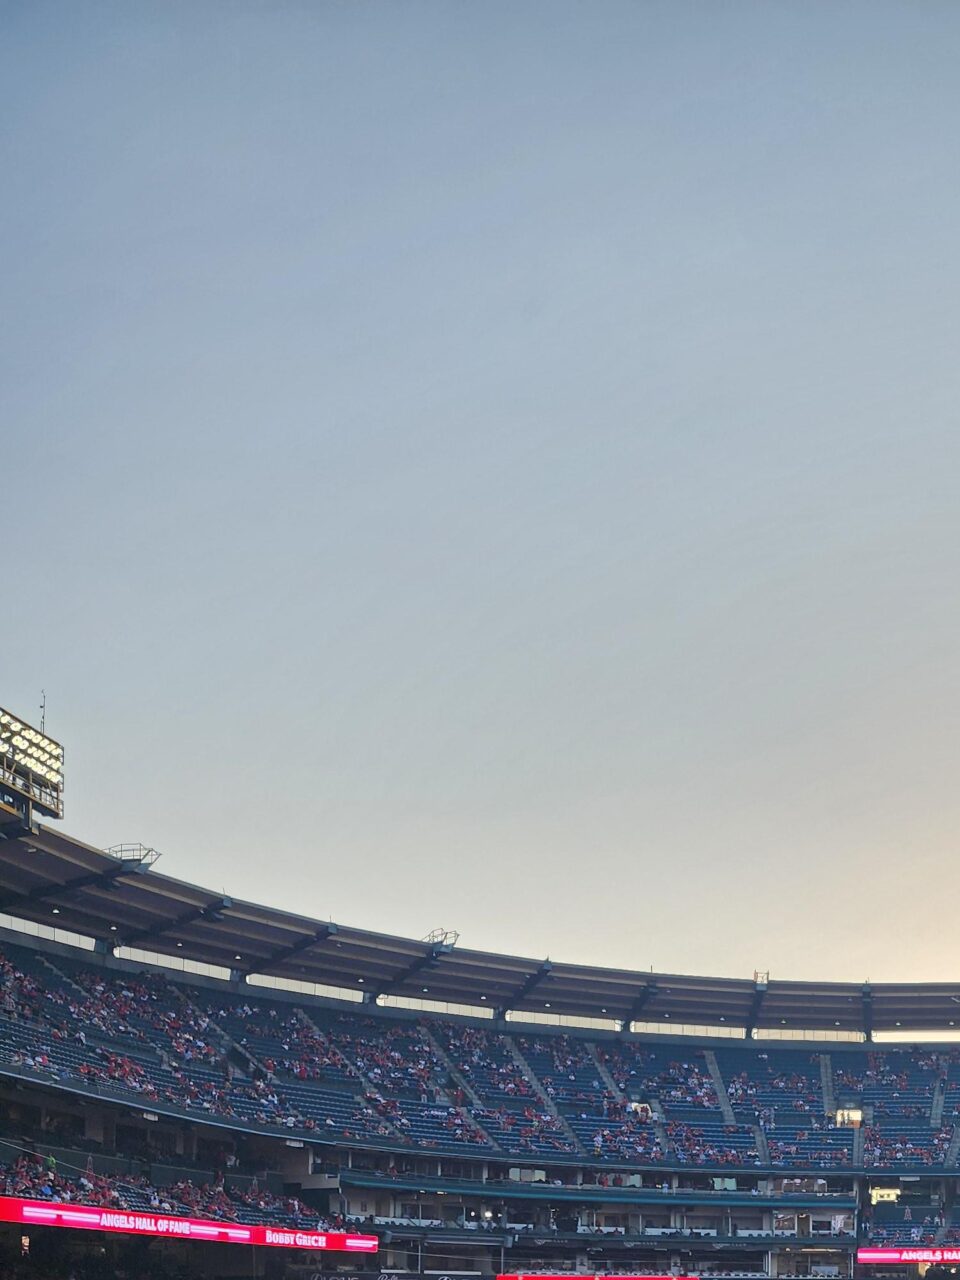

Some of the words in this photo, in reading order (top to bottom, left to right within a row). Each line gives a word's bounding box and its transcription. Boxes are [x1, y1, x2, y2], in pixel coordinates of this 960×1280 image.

[101, 1213, 135, 1228] ANGELS
[136, 1217, 156, 1231] HALL
[158, 1220, 169, 1232] OF
[169, 1221, 191, 1234] FAME
[266, 1230, 295, 1245] BOBBY
[296, 1233, 326, 1247] GRICH
[901, 1251, 942, 1260] ANGELS
